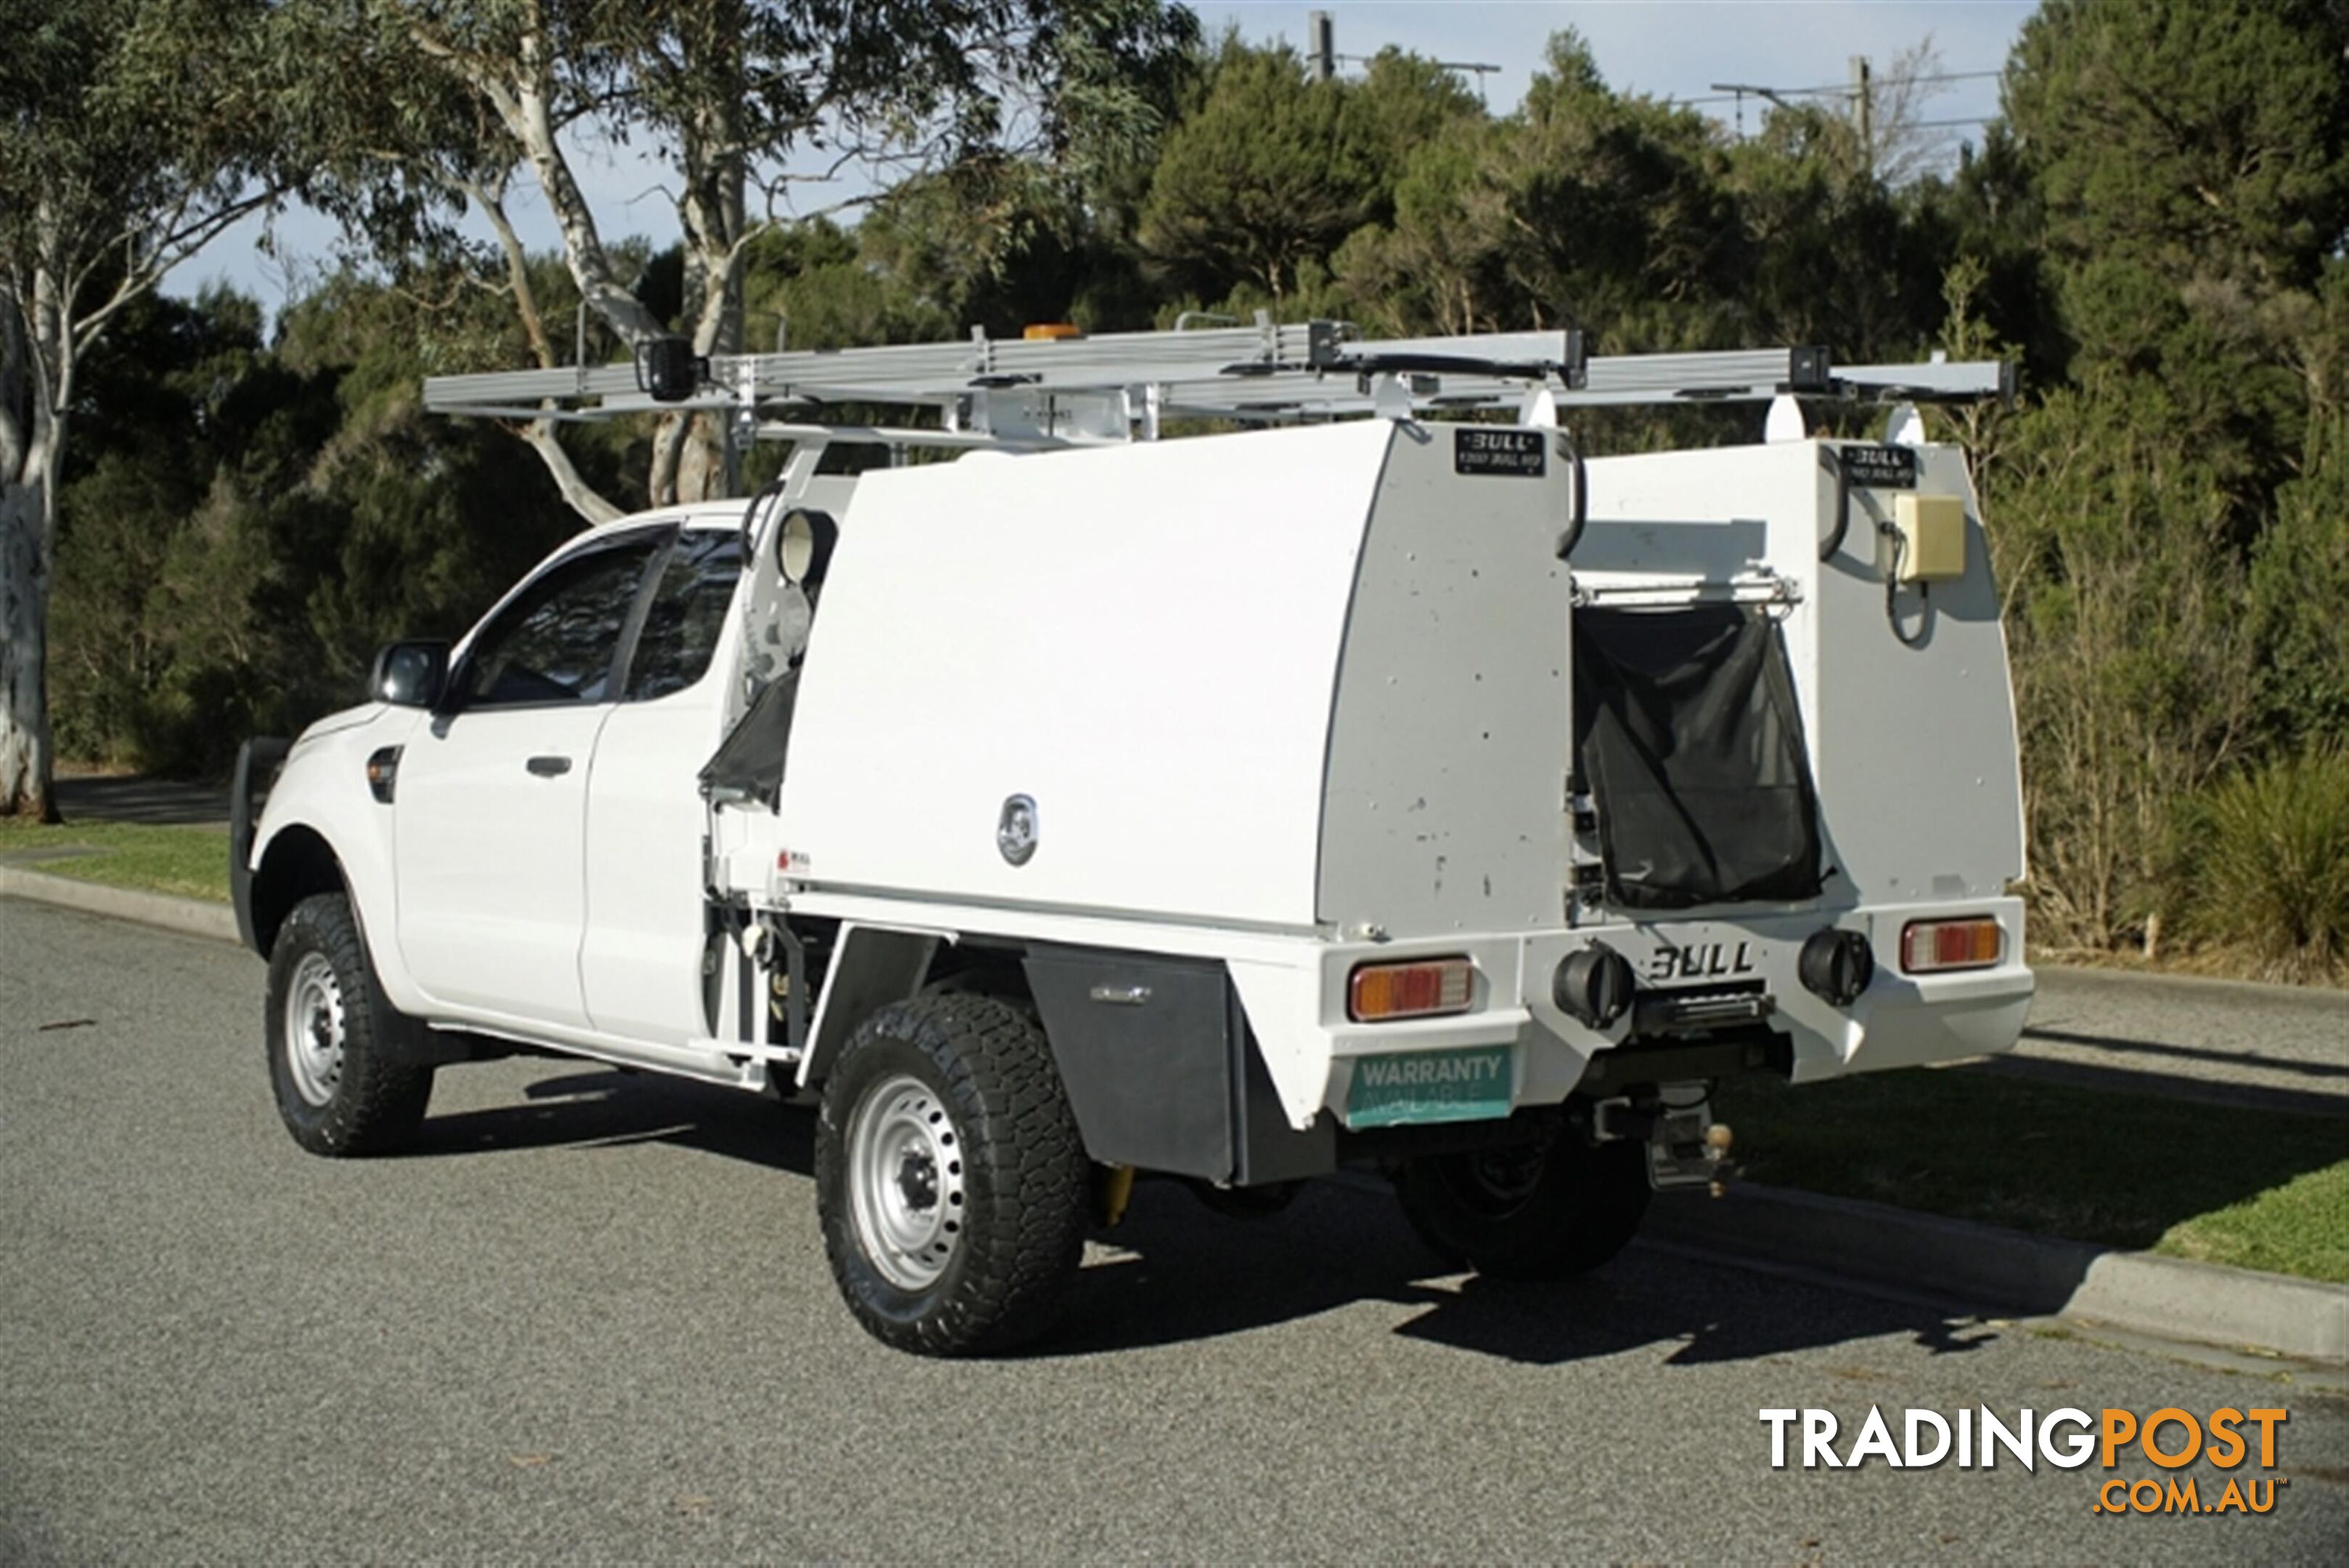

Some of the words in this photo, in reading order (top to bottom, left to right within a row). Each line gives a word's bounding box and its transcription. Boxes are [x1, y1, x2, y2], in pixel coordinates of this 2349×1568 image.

[1470, 433, 1527, 451] BULL
[1649, 942, 1754, 980] BULL
[1362, 1055, 1503, 1088] WARRANTY
